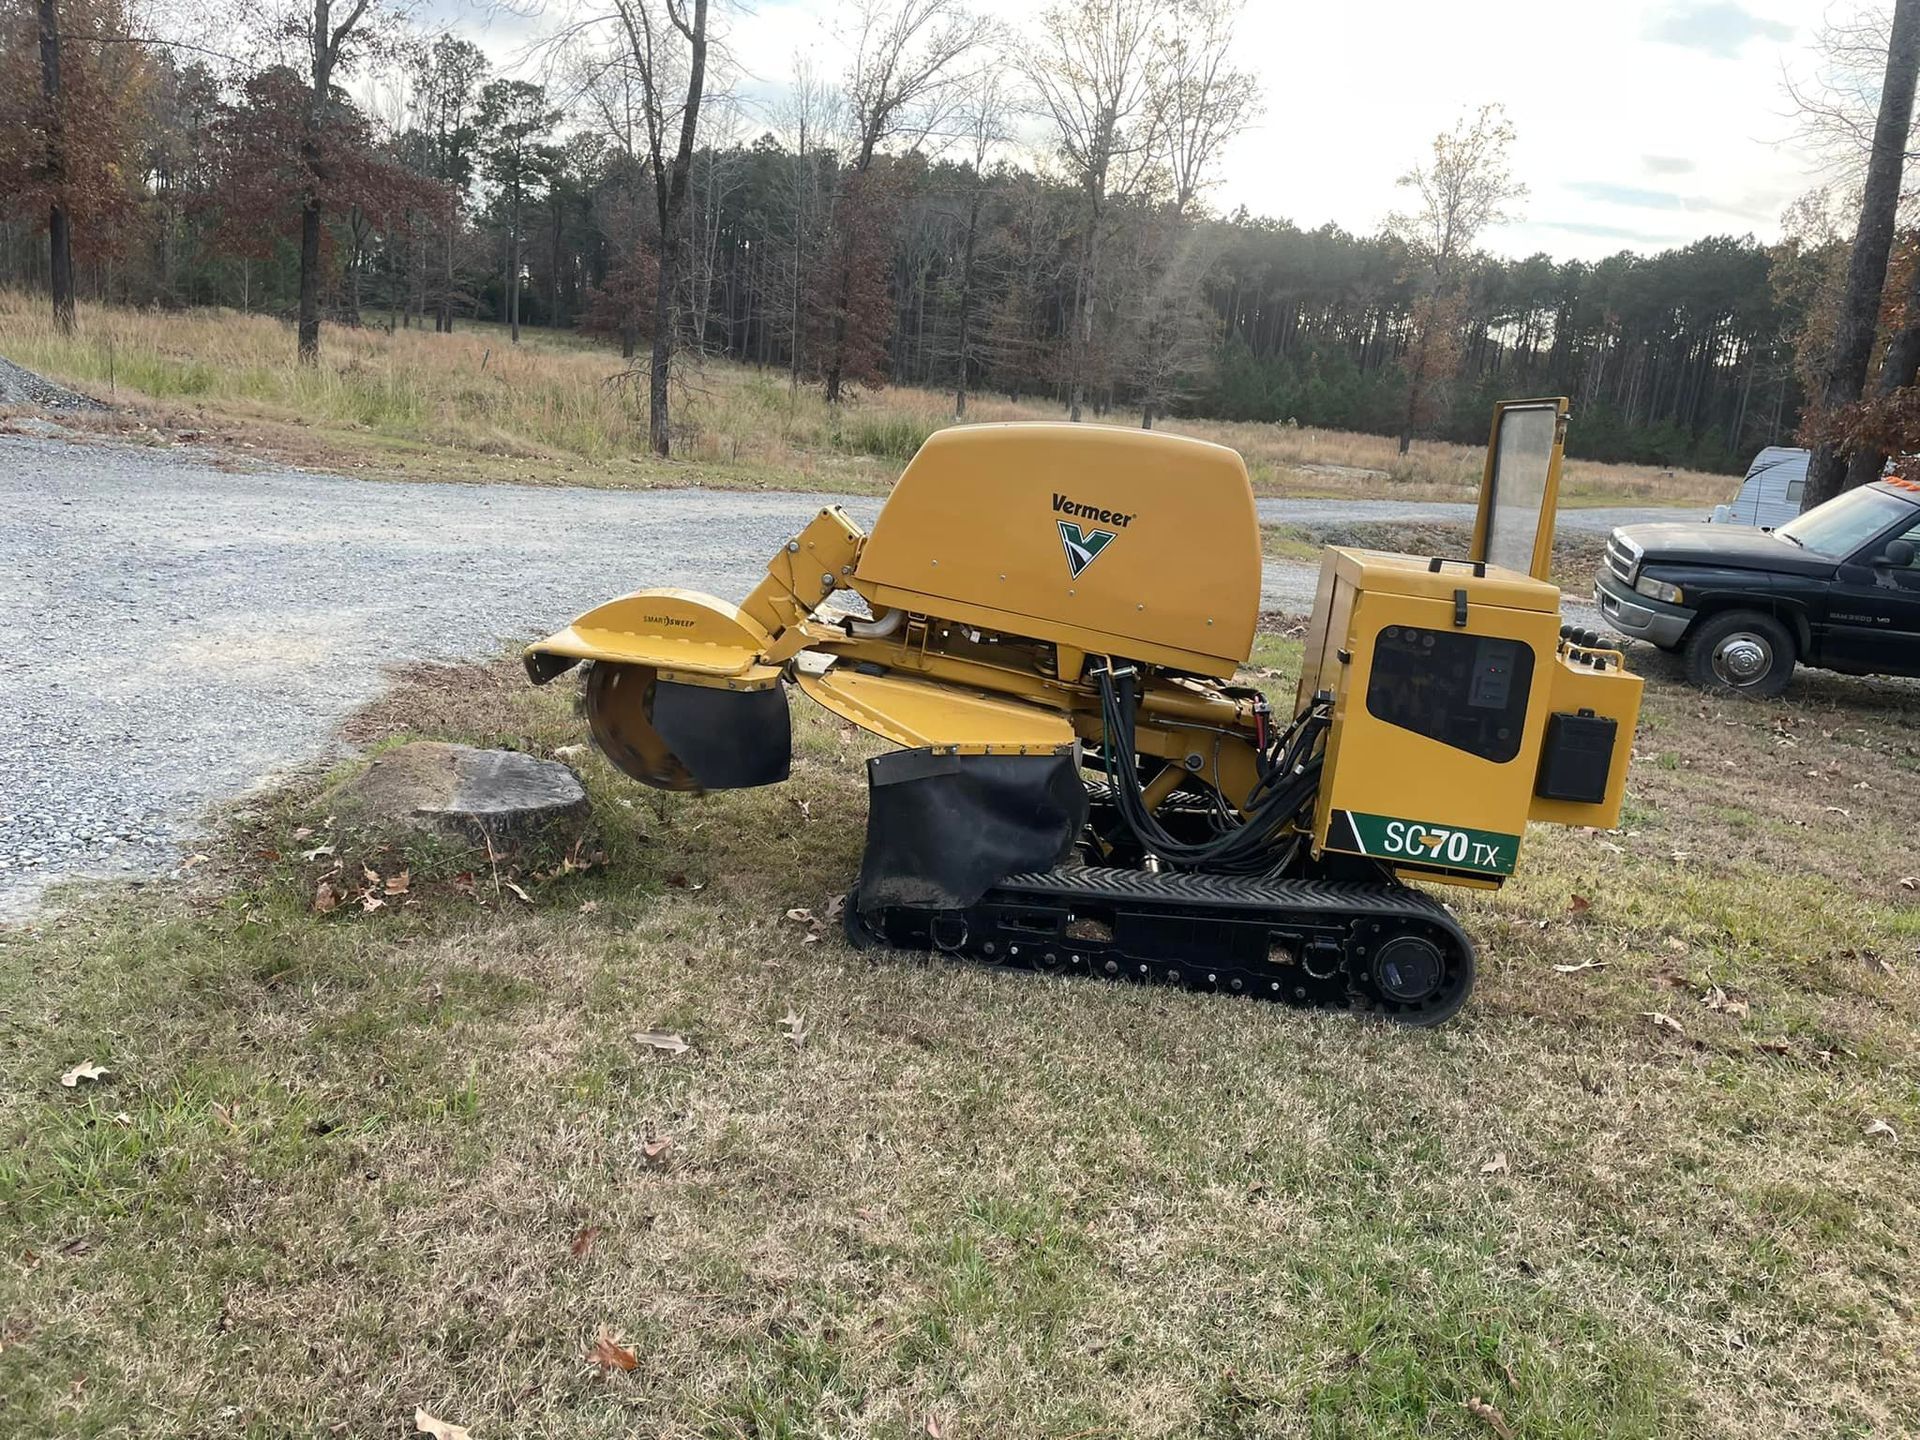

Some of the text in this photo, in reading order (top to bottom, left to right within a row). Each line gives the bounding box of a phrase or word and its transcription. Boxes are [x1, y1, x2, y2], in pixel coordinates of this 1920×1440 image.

[1052, 492, 1132, 528] Vermeer
[1383, 820, 1501, 868] SC70 TX
